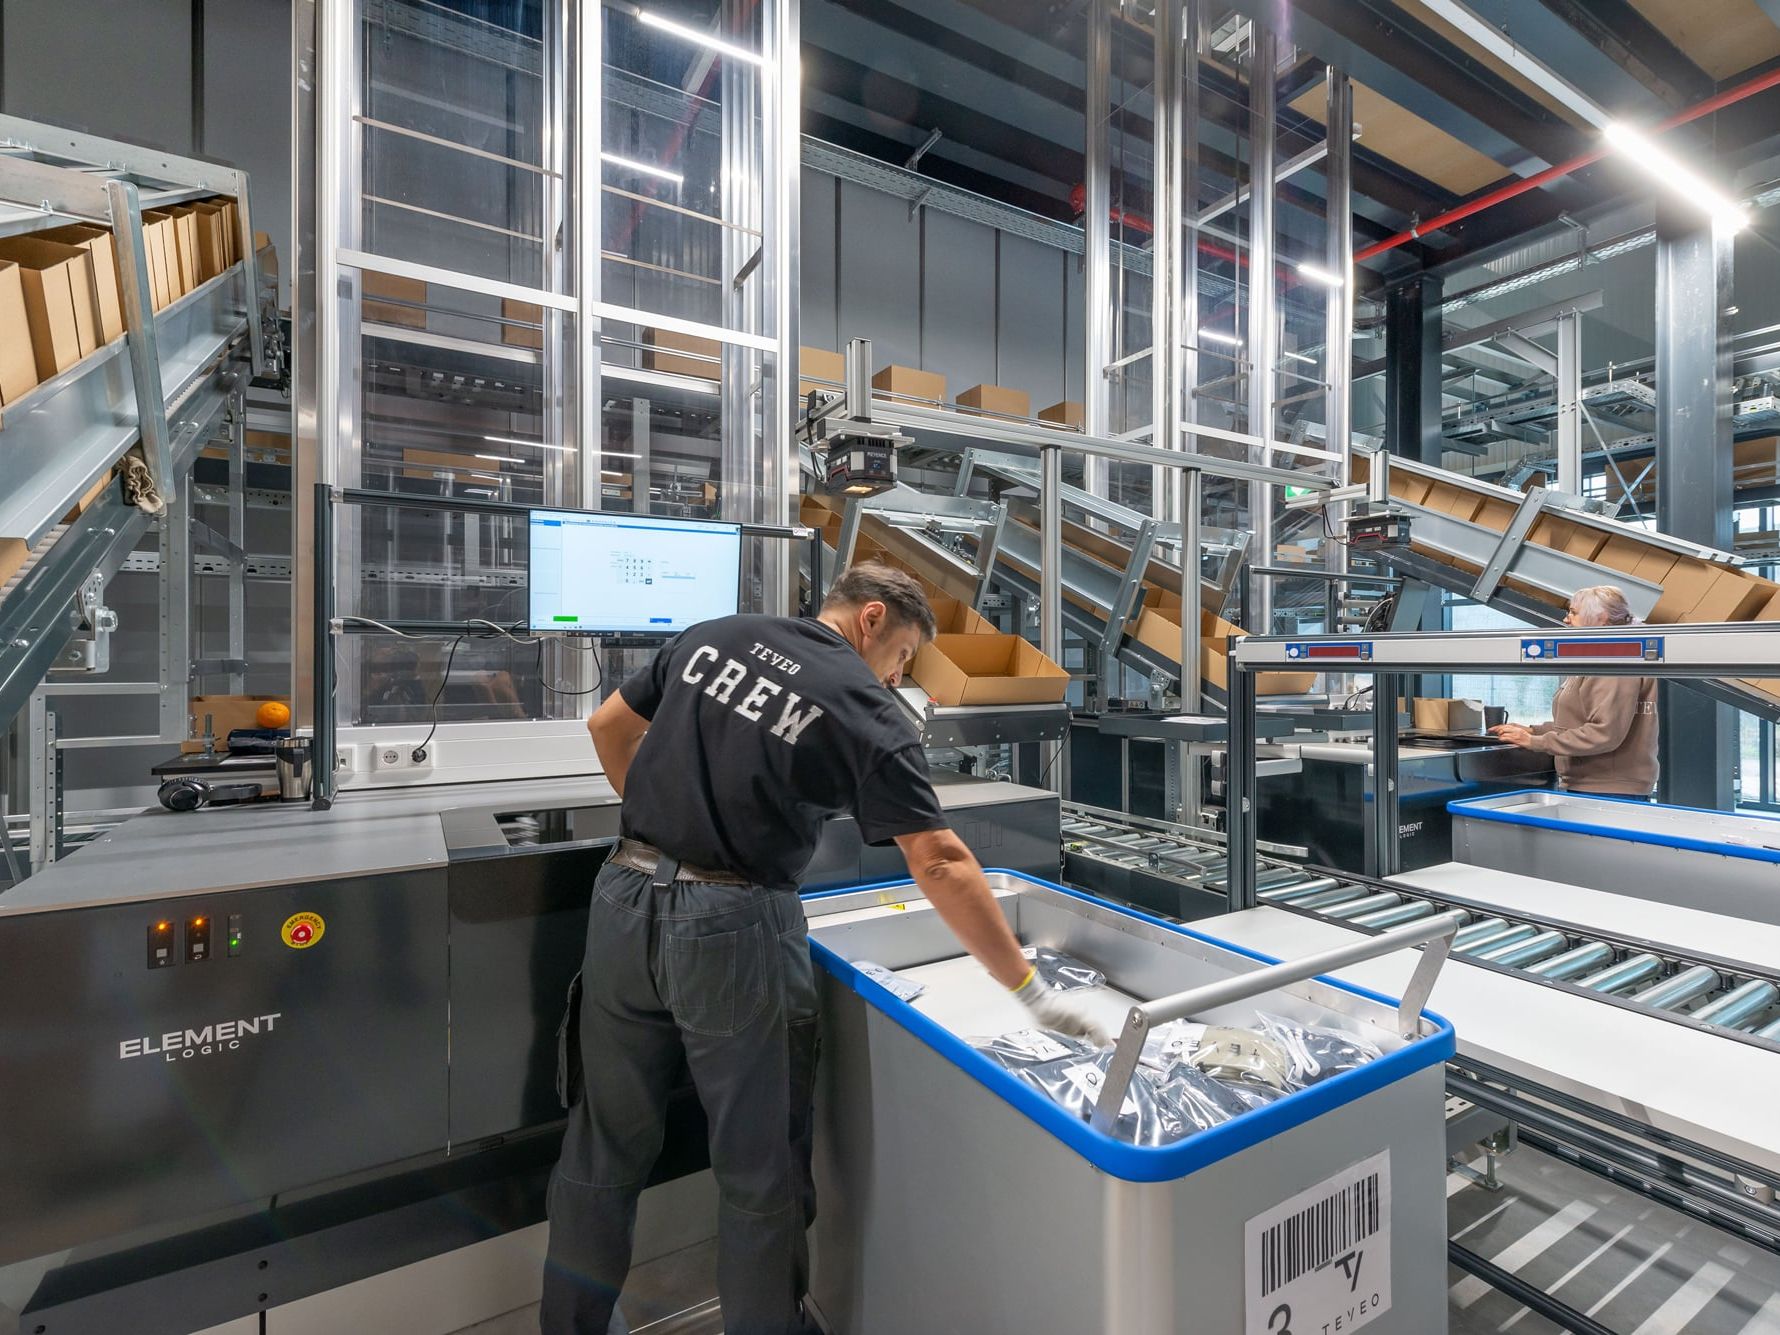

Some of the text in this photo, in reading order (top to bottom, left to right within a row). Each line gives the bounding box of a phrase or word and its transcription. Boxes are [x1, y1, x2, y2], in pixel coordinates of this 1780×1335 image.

[749, 643, 801, 675] TEVEO
[682, 645, 824, 745] CREW
[1399, 821, 1423, 833] EMENT
[120, 1013, 281, 1059] ELEMENT
[166, 1040, 240, 1062] LOGIC
[1321, 1293, 1379, 1335] TEVEO
